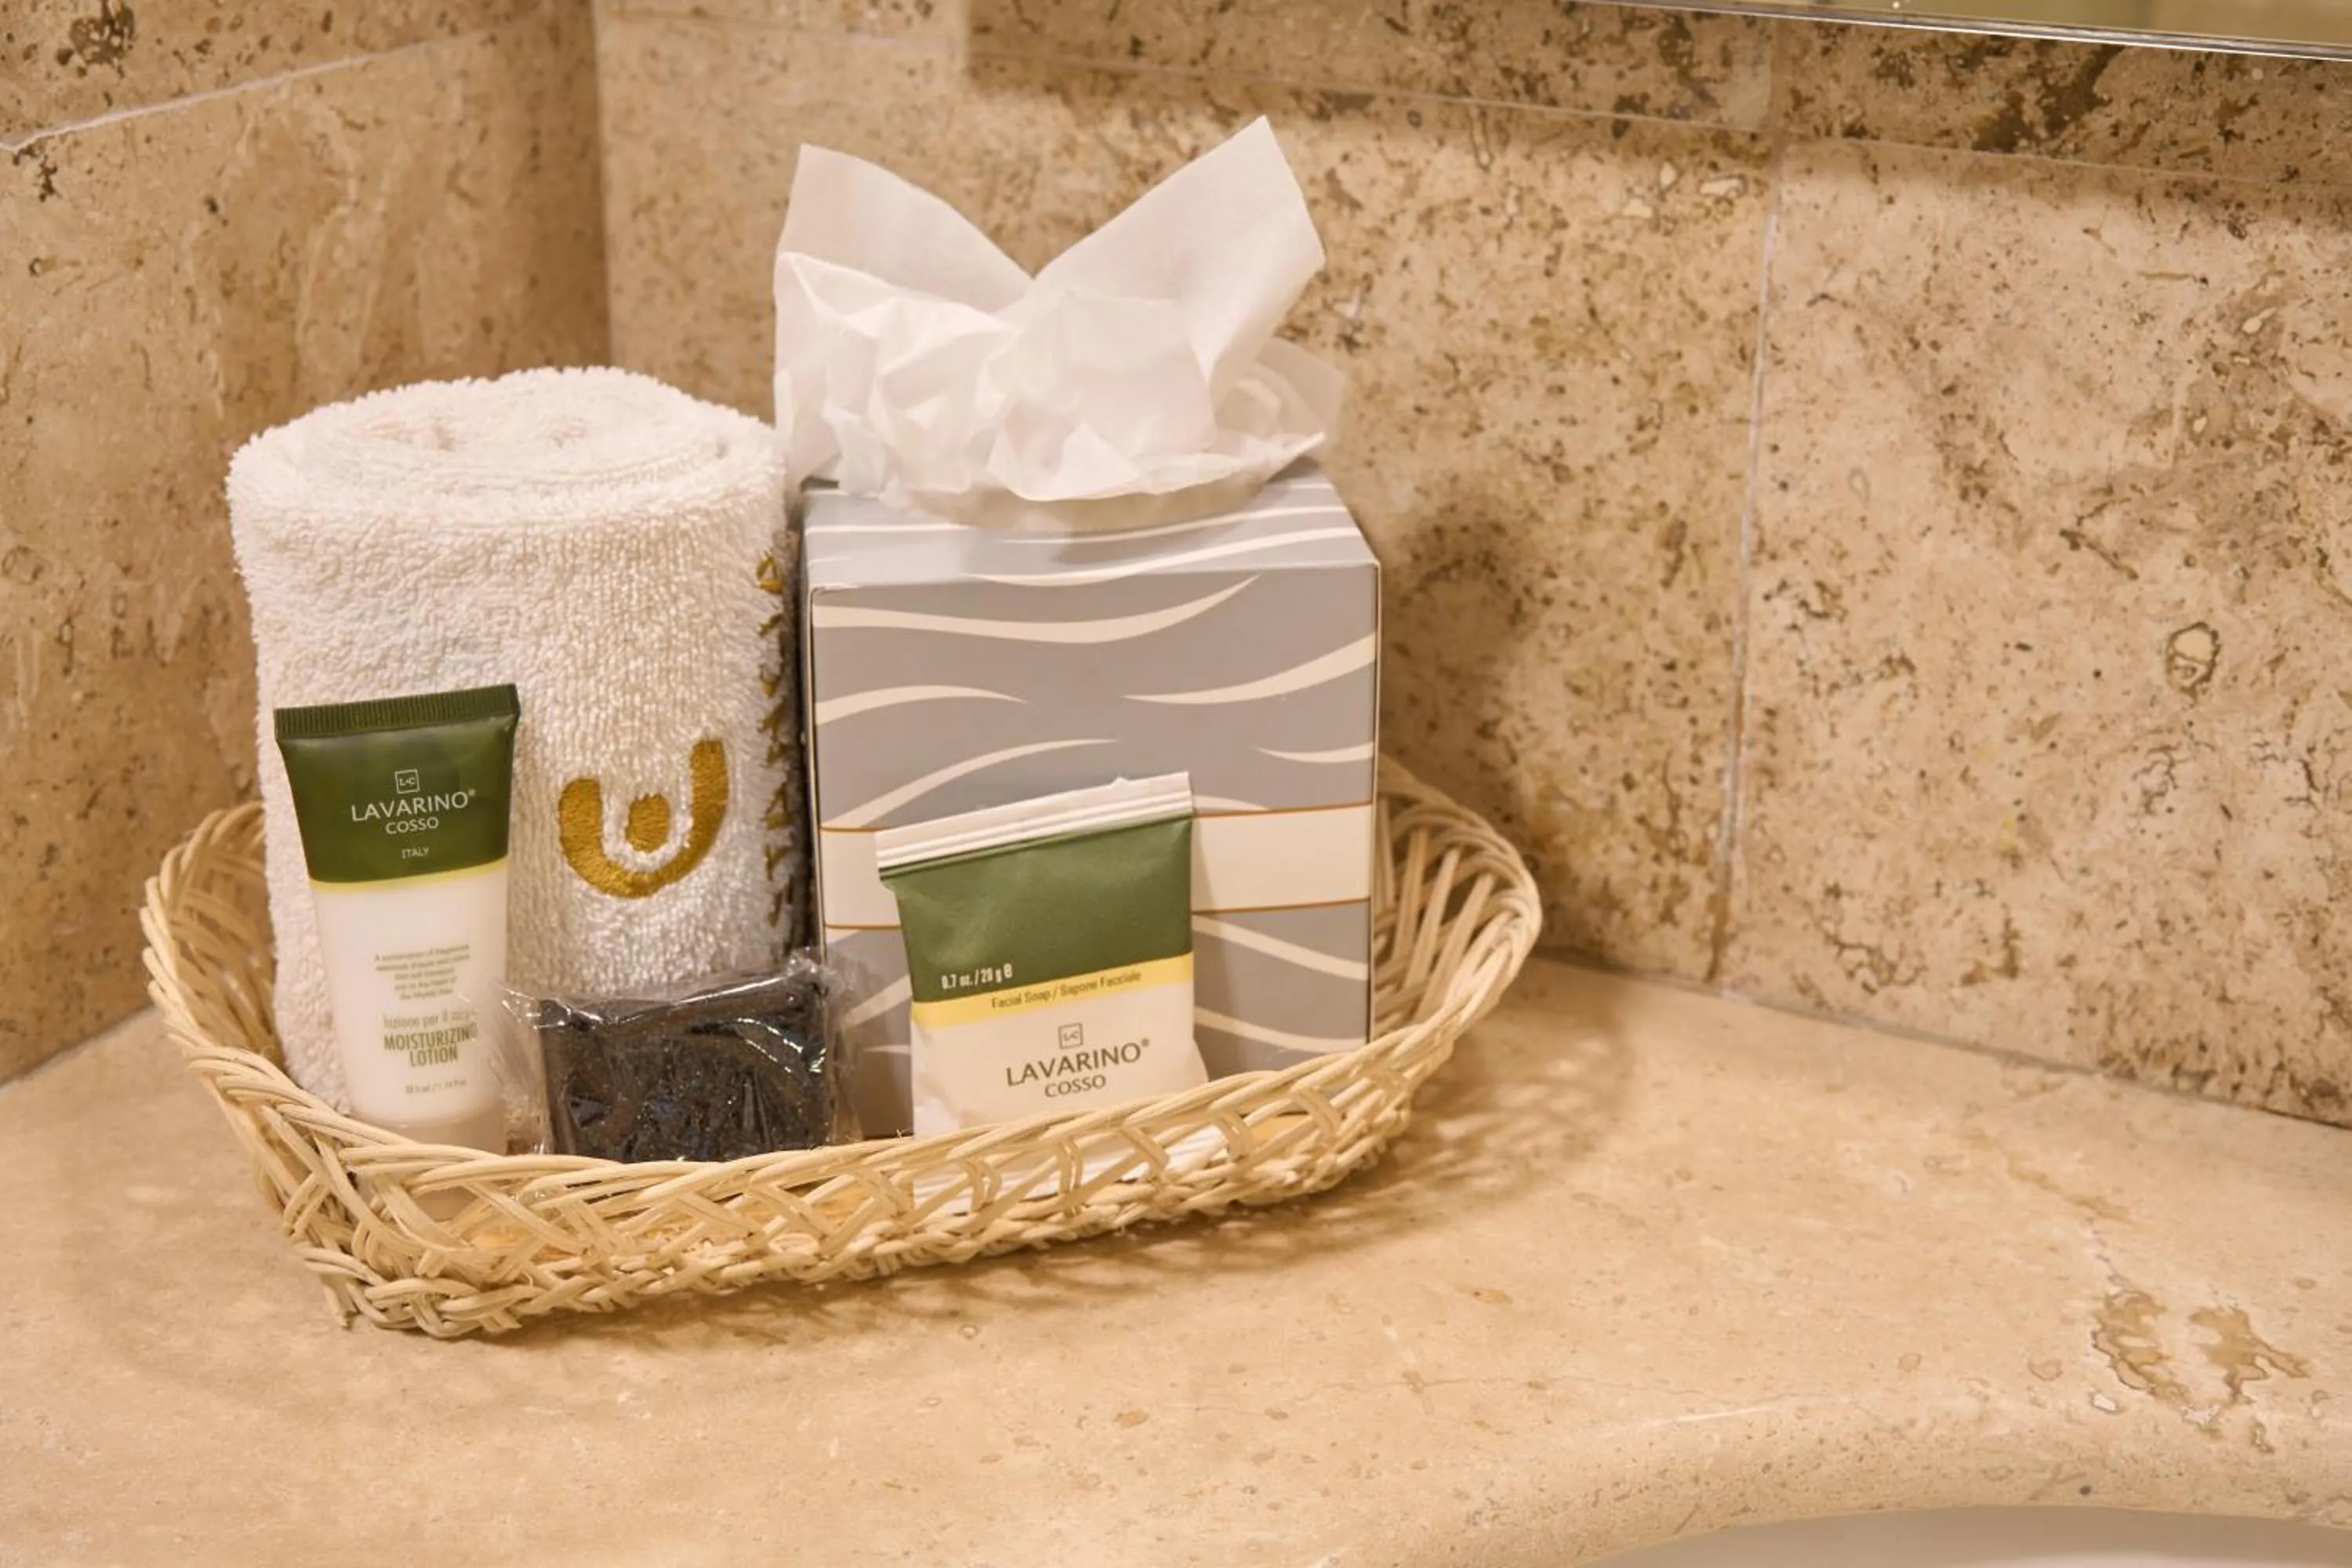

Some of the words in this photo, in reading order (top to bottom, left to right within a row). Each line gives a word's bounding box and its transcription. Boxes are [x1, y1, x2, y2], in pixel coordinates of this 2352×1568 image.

[385, 816, 439, 835] COSSO
[401, 846, 430, 859] ITALY
[942, 973, 956, 989] 0.7
[992, 993, 1022, 1008] Facial
[1024, 989, 1051, 1004] Soap
[1060, 979, 1098, 996] Sapone
[1100, 971, 1142, 987] Facciale
[409, 1042, 458, 1067] LOTION
[1044, 1074, 1106, 1098] COSSO
